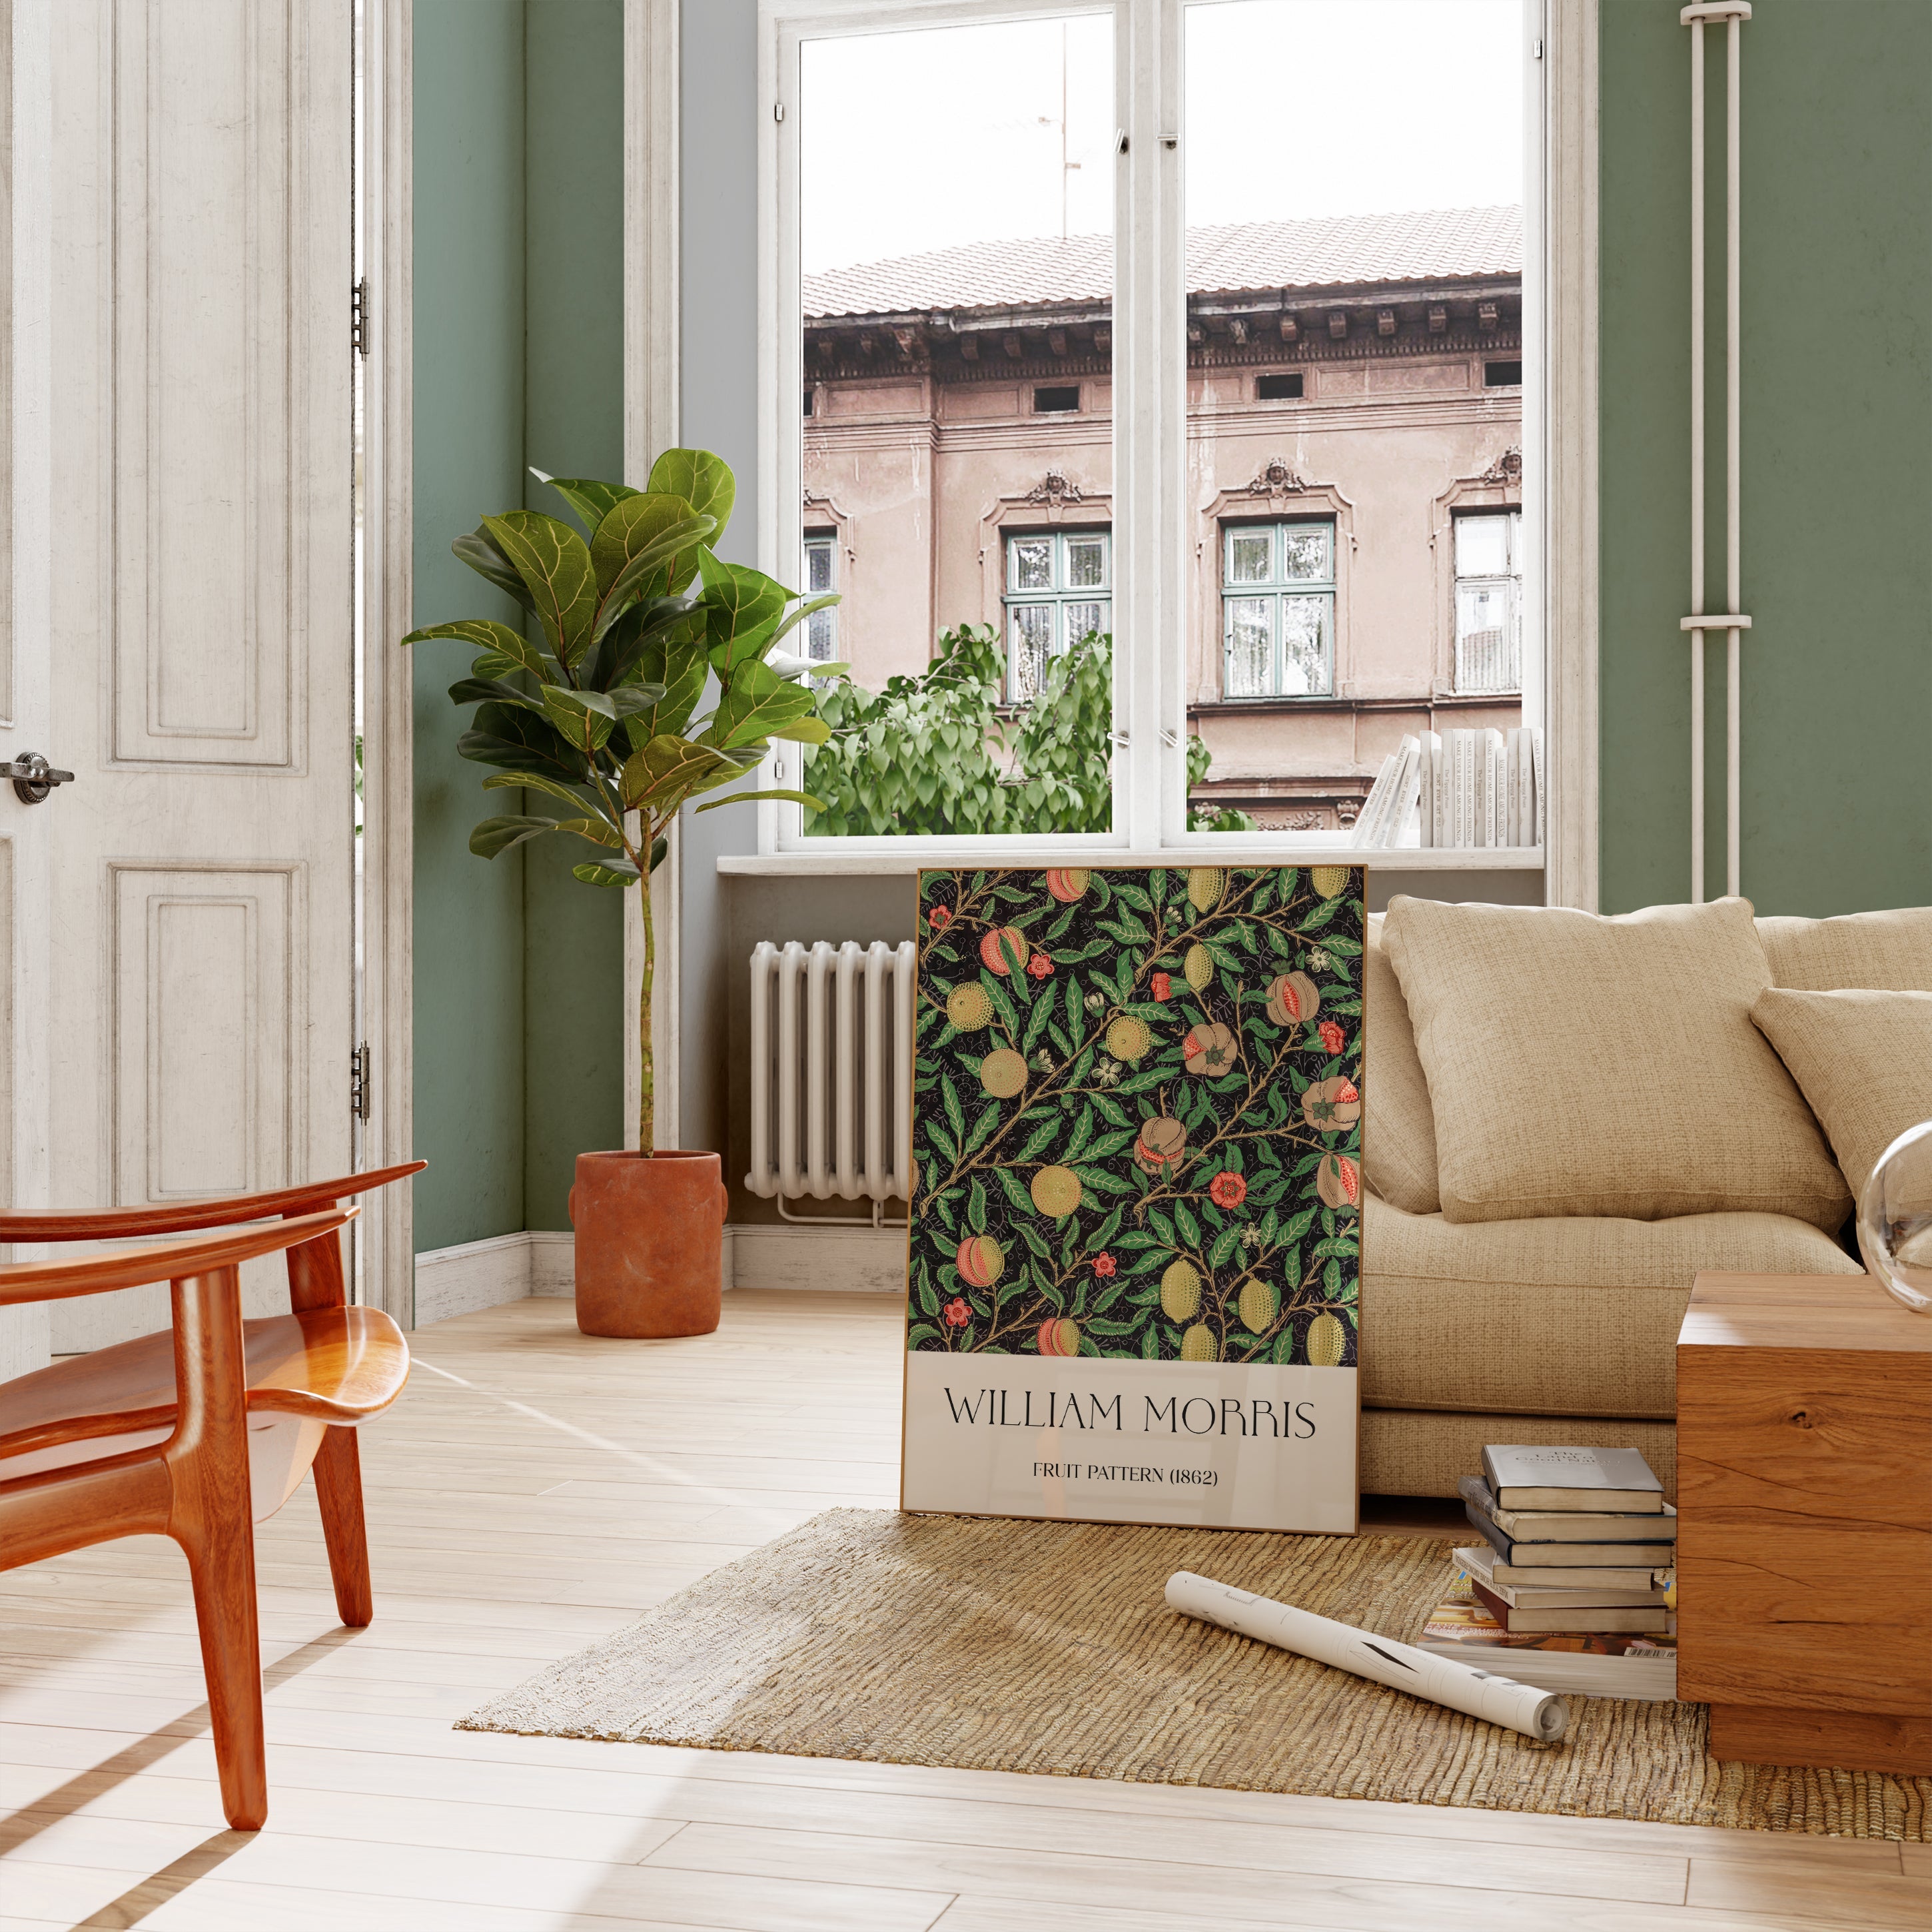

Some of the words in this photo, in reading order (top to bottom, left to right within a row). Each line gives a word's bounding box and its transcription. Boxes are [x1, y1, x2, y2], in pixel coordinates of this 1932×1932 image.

[1398, 746, 1407, 760] MAKE
[1386, 777, 1396, 795] HOME
[1377, 795, 1388, 817] AMONG
[1370, 817, 1380, 841] FRIENDS
[943, 1388, 1123, 1430] WILLIAM
[1143, 1396, 1316, 1439] MORRIS
[1034, 1462, 1083, 1480] FRUIT
[1087, 1465, 1164, 1482] PATTERN
[1170, 1469, 1218, 1486] (1862)
